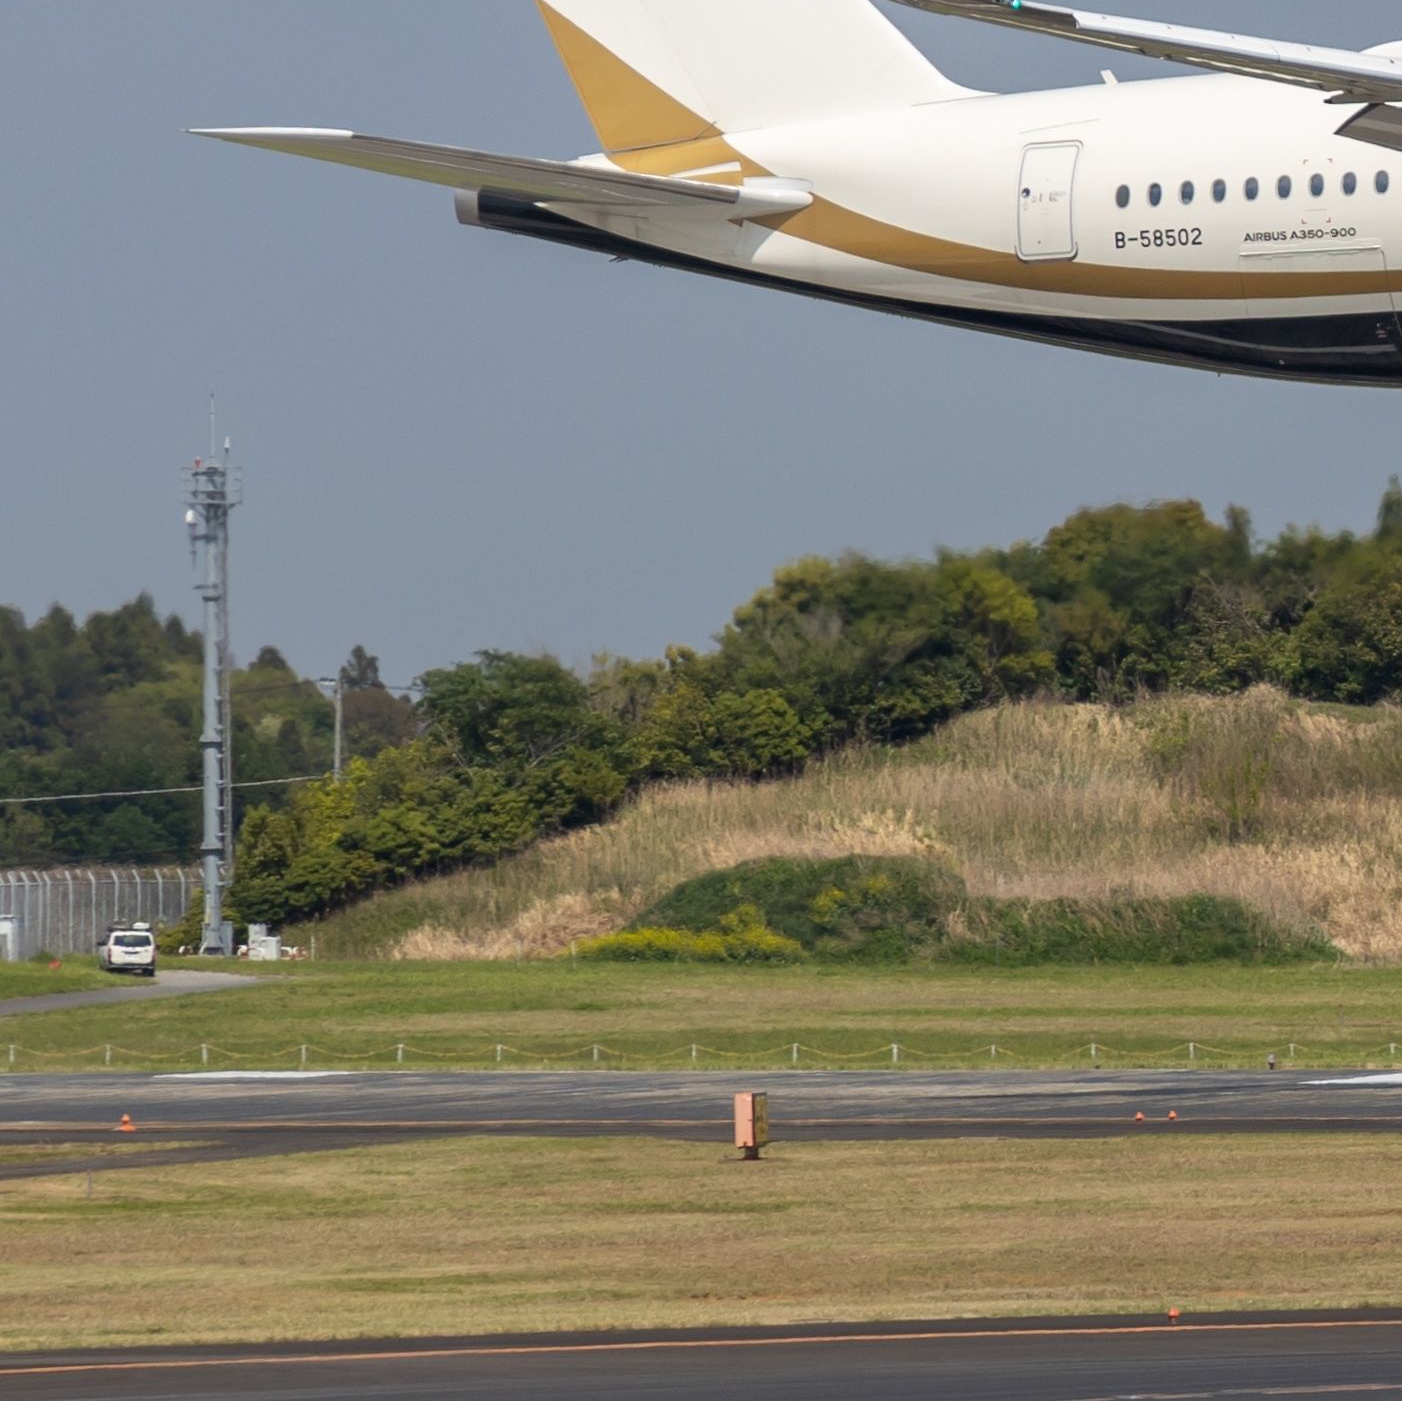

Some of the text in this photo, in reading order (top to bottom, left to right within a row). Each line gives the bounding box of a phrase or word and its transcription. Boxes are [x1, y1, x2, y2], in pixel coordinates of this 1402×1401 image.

[1114, 227, 1203, 249] B-58502
[1243, 227, 1357, 242] AIRBUS A350-900
